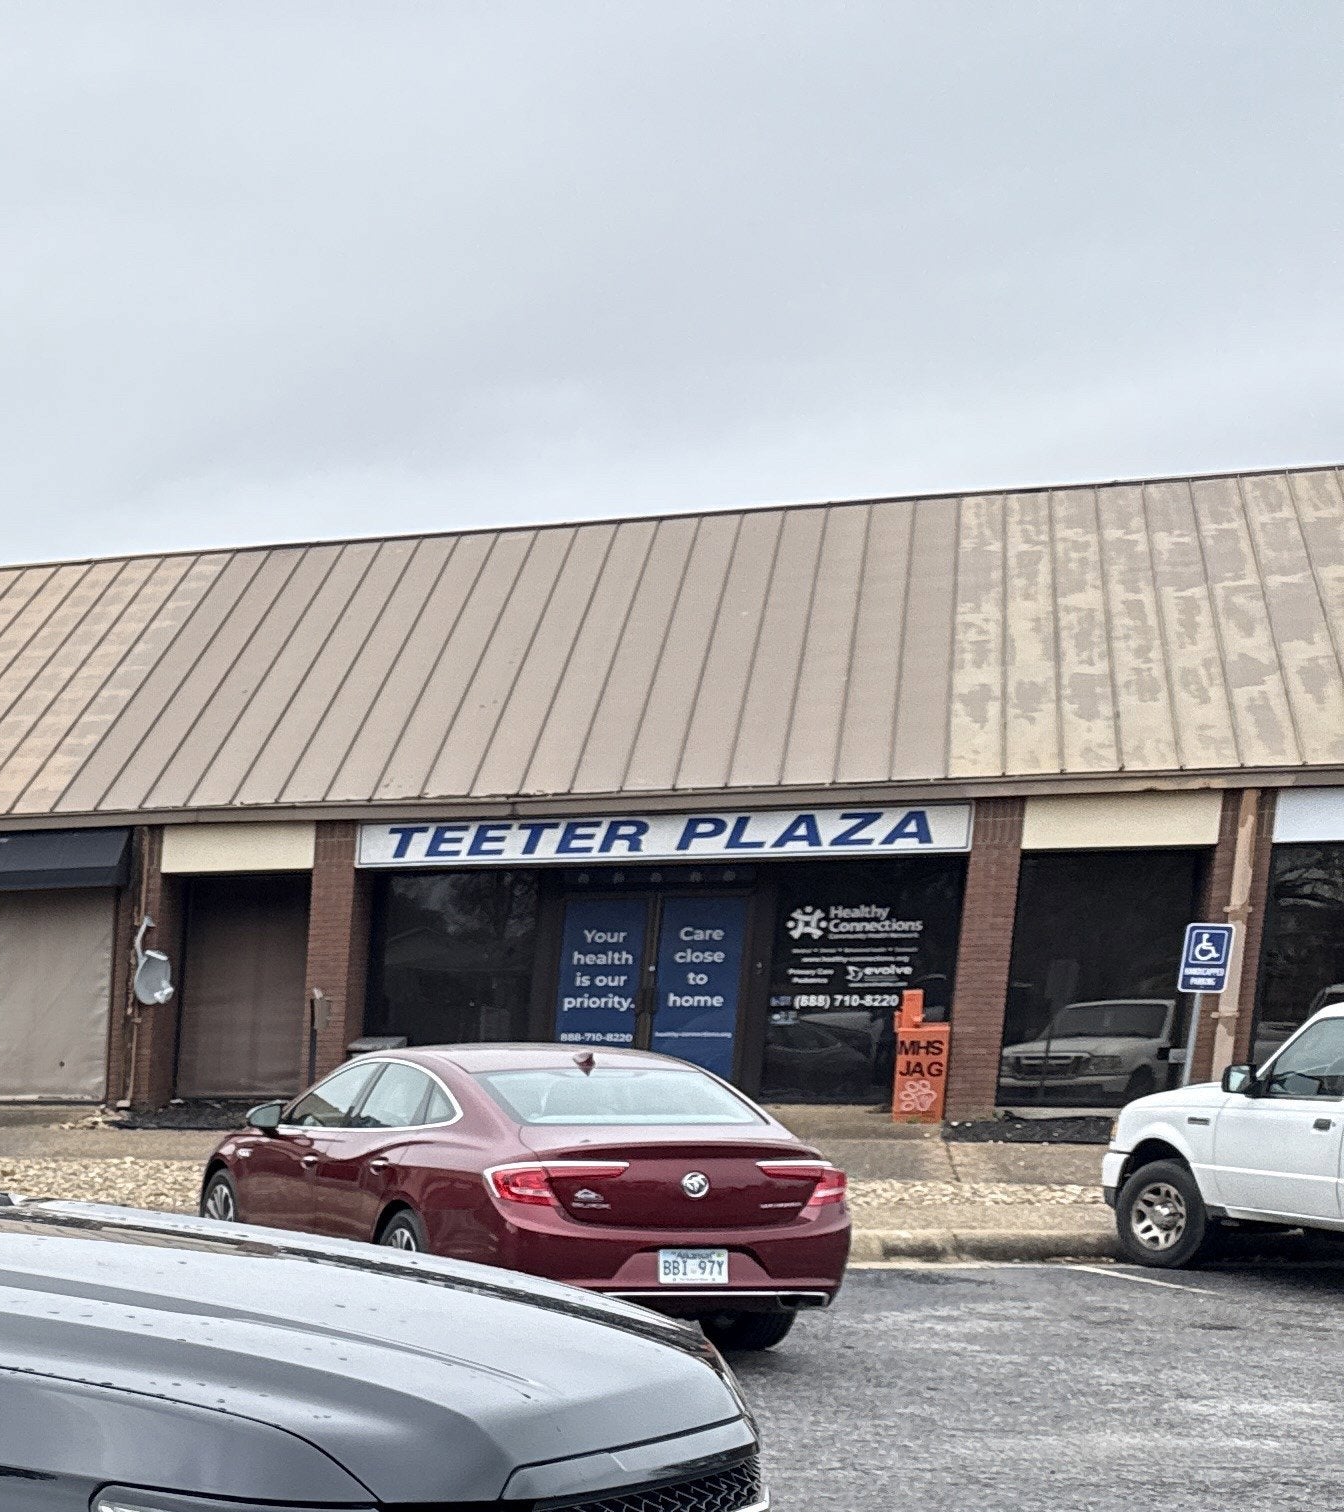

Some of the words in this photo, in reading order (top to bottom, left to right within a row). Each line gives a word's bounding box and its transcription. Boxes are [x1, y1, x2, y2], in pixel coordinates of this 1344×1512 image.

[388, 820, 649, 859] TEETER
[675, 810, 934, 850] PLAZA
[829, 905, 890, 920] Healthy
[679, 926, 725, 941] Care
[829, 919, 923, 933] Connections
[583, 929, 627, 944] Your
[573, 951, 633, 965] health
[674, 948, 726, 963] close
[863, 964, 913, 975] evolve
[575, 971, 591, 987] is
[594, 974, 627, 987] our
[686, 972, 708, 985] to
[563, 993, 635, 1012] priority.
[668, 992, 724, 1007] home
[793, 994, 831, 1010] (888)
[833, 994, 900, 1007] 710-8220
[560, 1032, 633, 1043] 888-710-8220
[898, 1040, 944, 1056] MHS
[899, 1062, 944, 1077] JAG
[698, 1260, 724, 1276] 97Y
